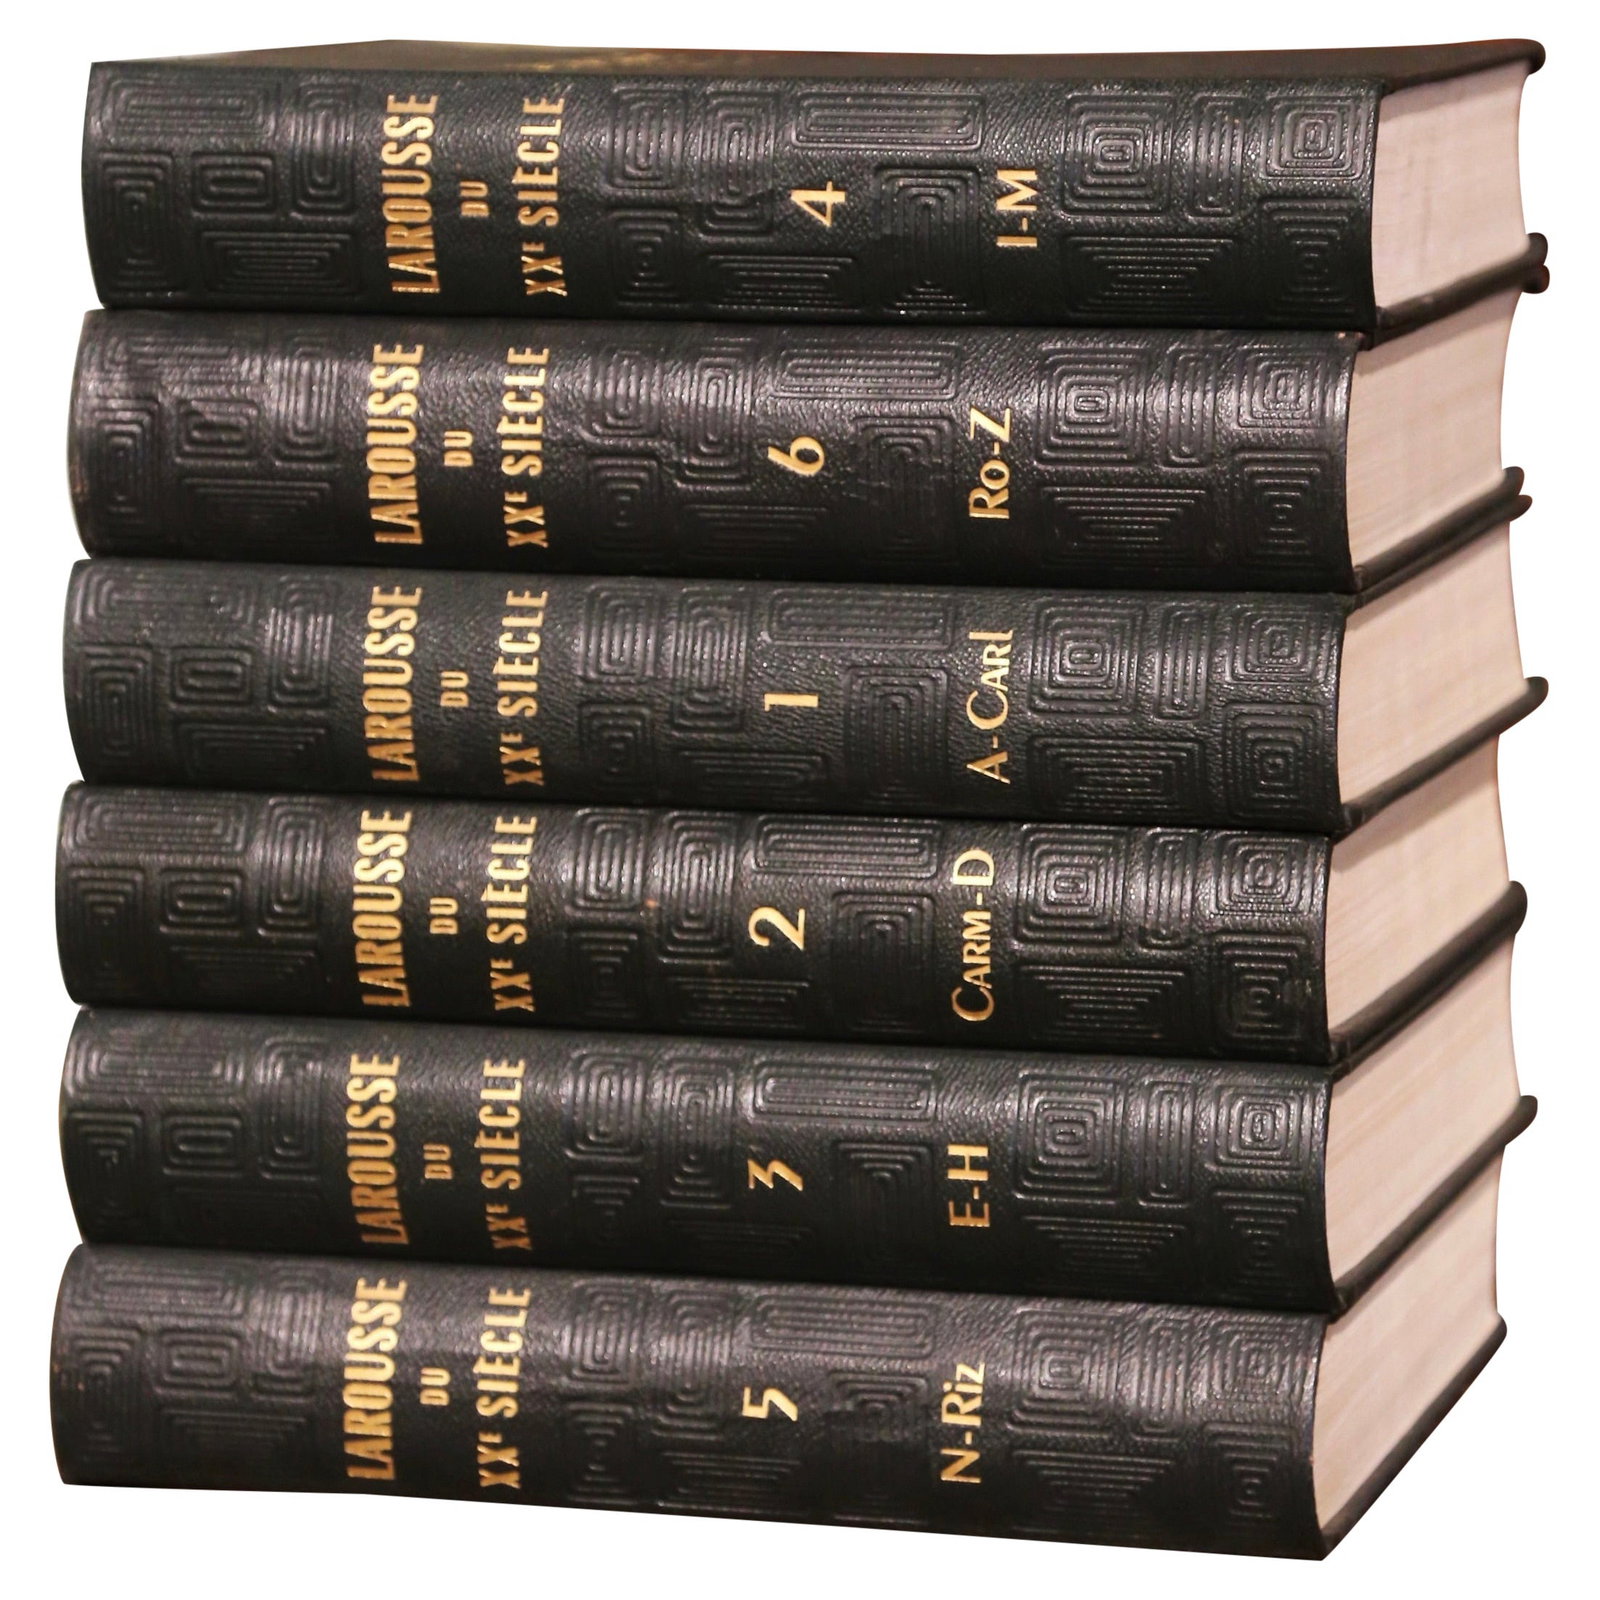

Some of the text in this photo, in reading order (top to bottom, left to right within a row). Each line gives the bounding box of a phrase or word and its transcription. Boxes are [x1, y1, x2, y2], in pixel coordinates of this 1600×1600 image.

[381, 94, 440, 293] LAROUSSE
[460, 180, 489, 218] DU
[512, 97, 564, 226] SIÈCLE
[790, 181, 846, 227] 4
[996, 170, 1037, 248] I-M
[366, 344, 424, 545] LAROUSSE
[444, 430, 474, 468] DU
[496, 348, 550, 476] SIÈCLE
[768, 436, 825, 477] 6
[362, 586, 422, 782] LAROUSSE
[440, 670, 469, 708] DU
[493, 590, 548, 717] SIÈCLE
[764, 691, 819, 711] 1
[352, 810, 413, 1007] LAROUSSE
[429, 897, 459, 935] DU
[481, 816, 537, 944] SIÈCLE
[748, 906, 805, 949] 2
[345, 1054, 406, 1245] LAROUSSE
[424, 1144, 452, 1180] DU
[474, 1060, 526, 1189] SIÈCLE
[748, 1160, 803, 1191] 3
[947, 1144, 990, 1228] E-H
[342, 1278, 408, 1481] LAROUSSE
[420, 1367, 451, 1406] DU
[472, 1288, 532, 1418] SIÈCLE
[742, 1386, 798, 1421] 5
